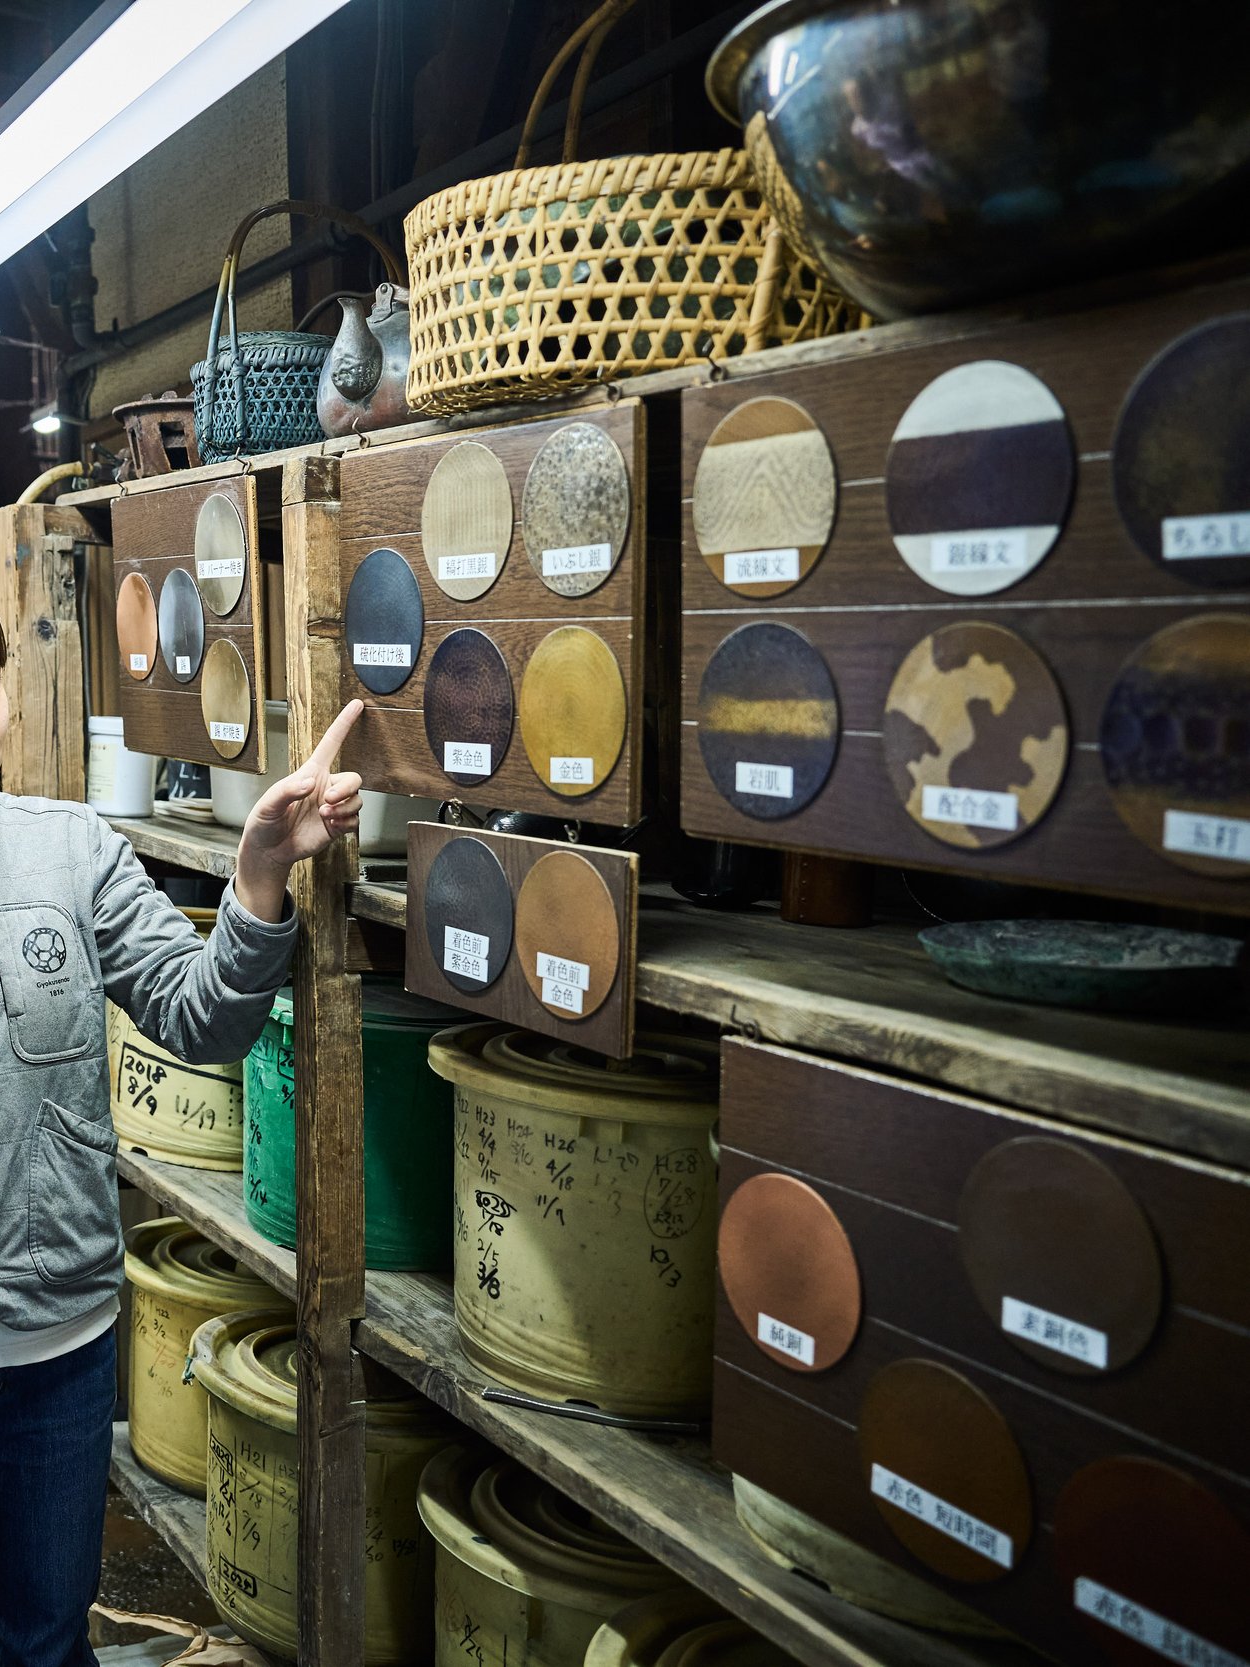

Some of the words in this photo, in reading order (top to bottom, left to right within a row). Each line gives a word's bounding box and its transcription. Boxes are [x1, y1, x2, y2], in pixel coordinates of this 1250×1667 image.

[552, 548, 601, 569] いぶし銀
[736, 556, 786, 578] 流線文
[452, 748, 484, 769] 紫金色
[559, 761, 584, 780] 金色
[452, 931, 483, 956] 着色前
[451, 953, 481, 978] 紫金色
[547, 957, 581, 985] 着色前
[36, 976, 70, 989] Gyokusendo
[49, 988, 65, 997] 1816
[551, 984, 574, 1008] 金色
[124, 1055, 167, 1085] 2018
[126, 1075, 158, 1116] 8/9
[476, 1105, 496, 1126] H23
[544, 1133, 576, 1154] H26
[545, 1159, 575, 1191] 4/18
[477, 1238, 499, 1268] 2/5
[240, 1441, 267, 1473] H21
[887, 1478, 923, 1514] 赤色
